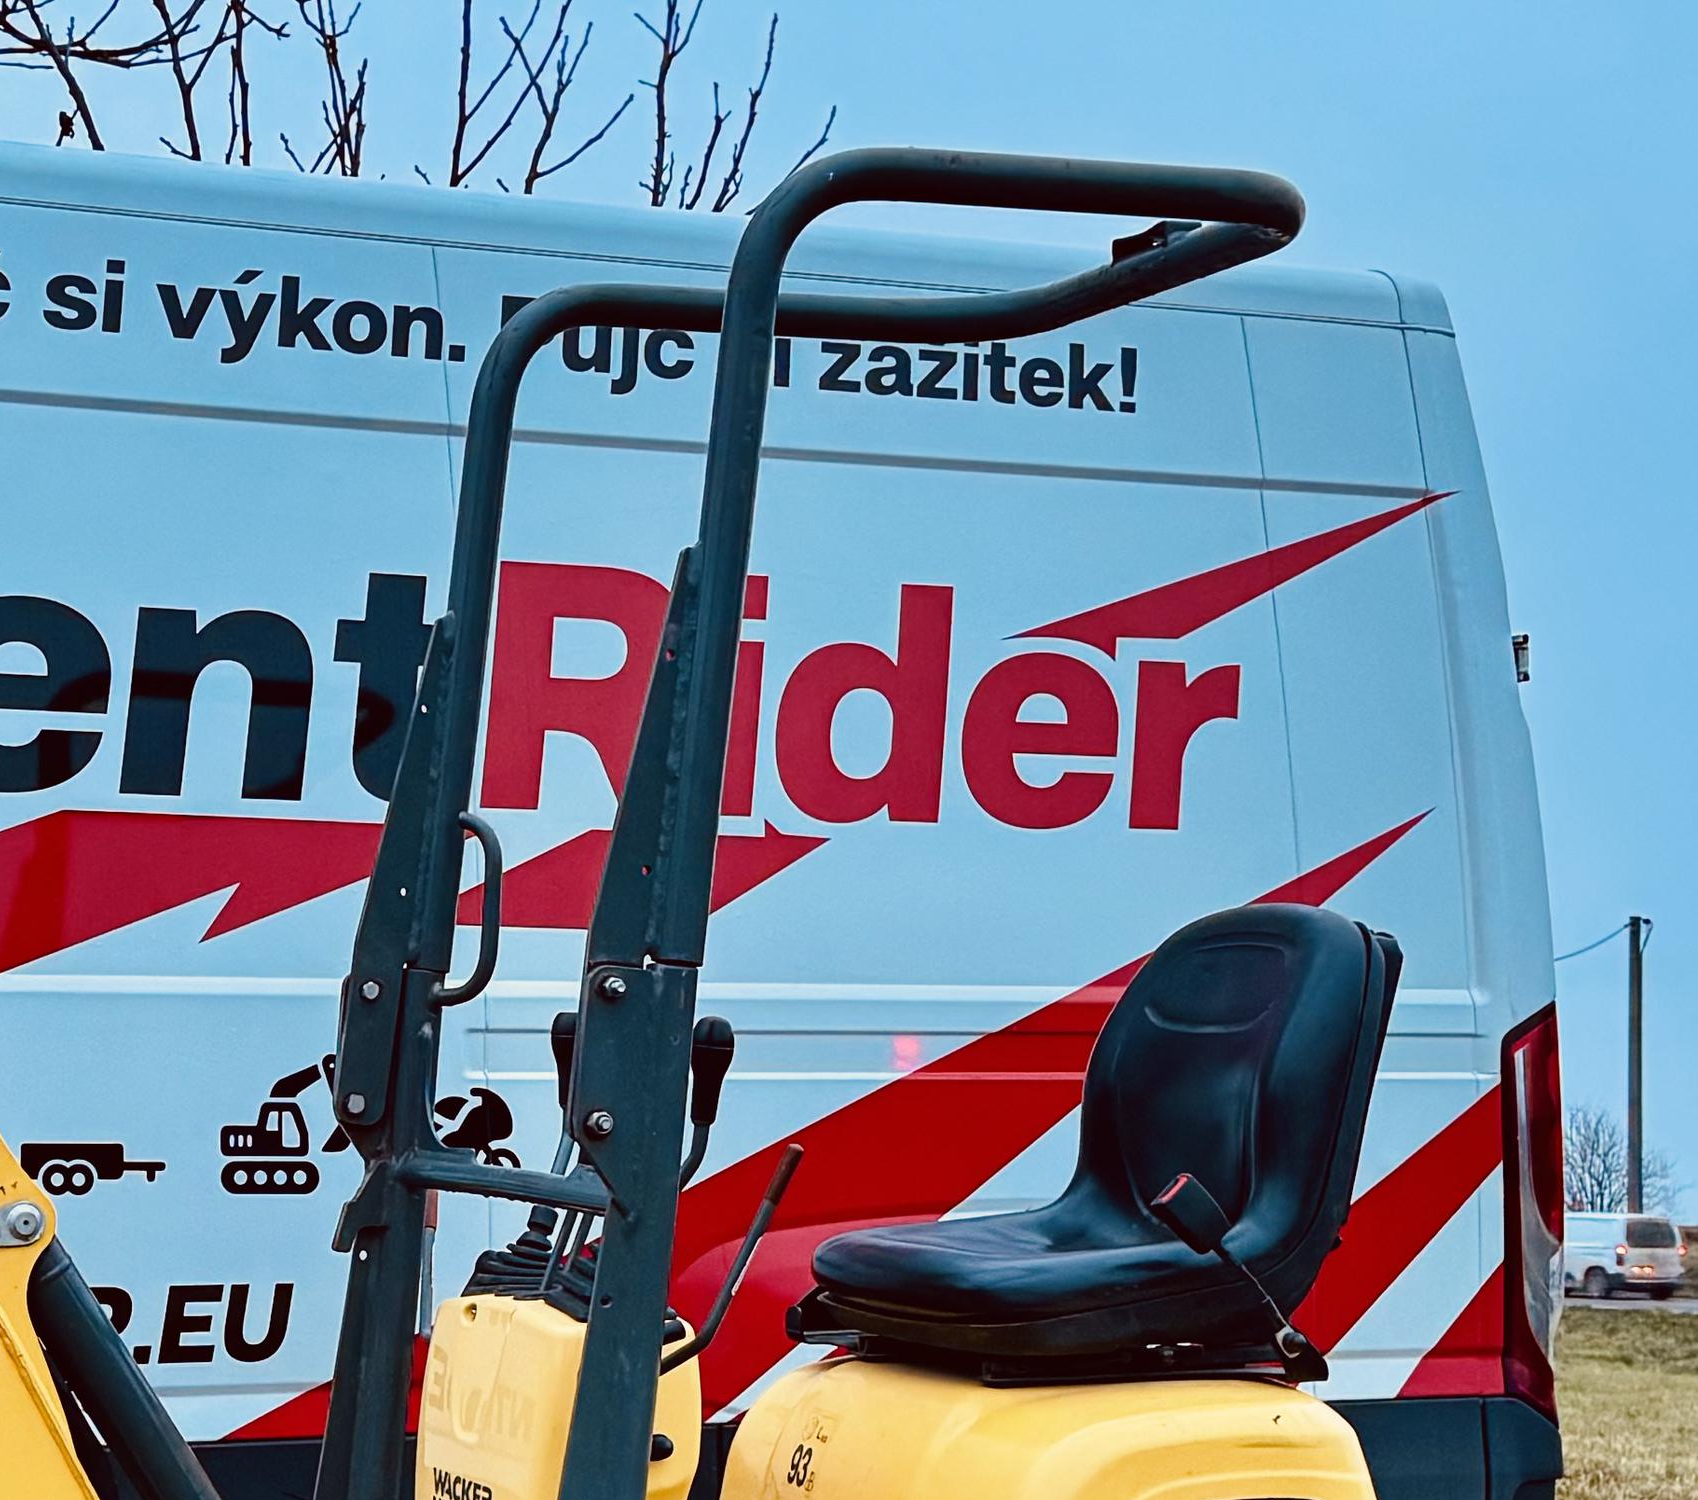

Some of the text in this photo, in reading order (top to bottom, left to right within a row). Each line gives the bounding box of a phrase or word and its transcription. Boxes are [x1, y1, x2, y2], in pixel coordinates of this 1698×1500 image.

[43, 258, 126, 334] si
[157, 269, 467, 364] výkon.
[787, 1444, 813, 1488] 93
